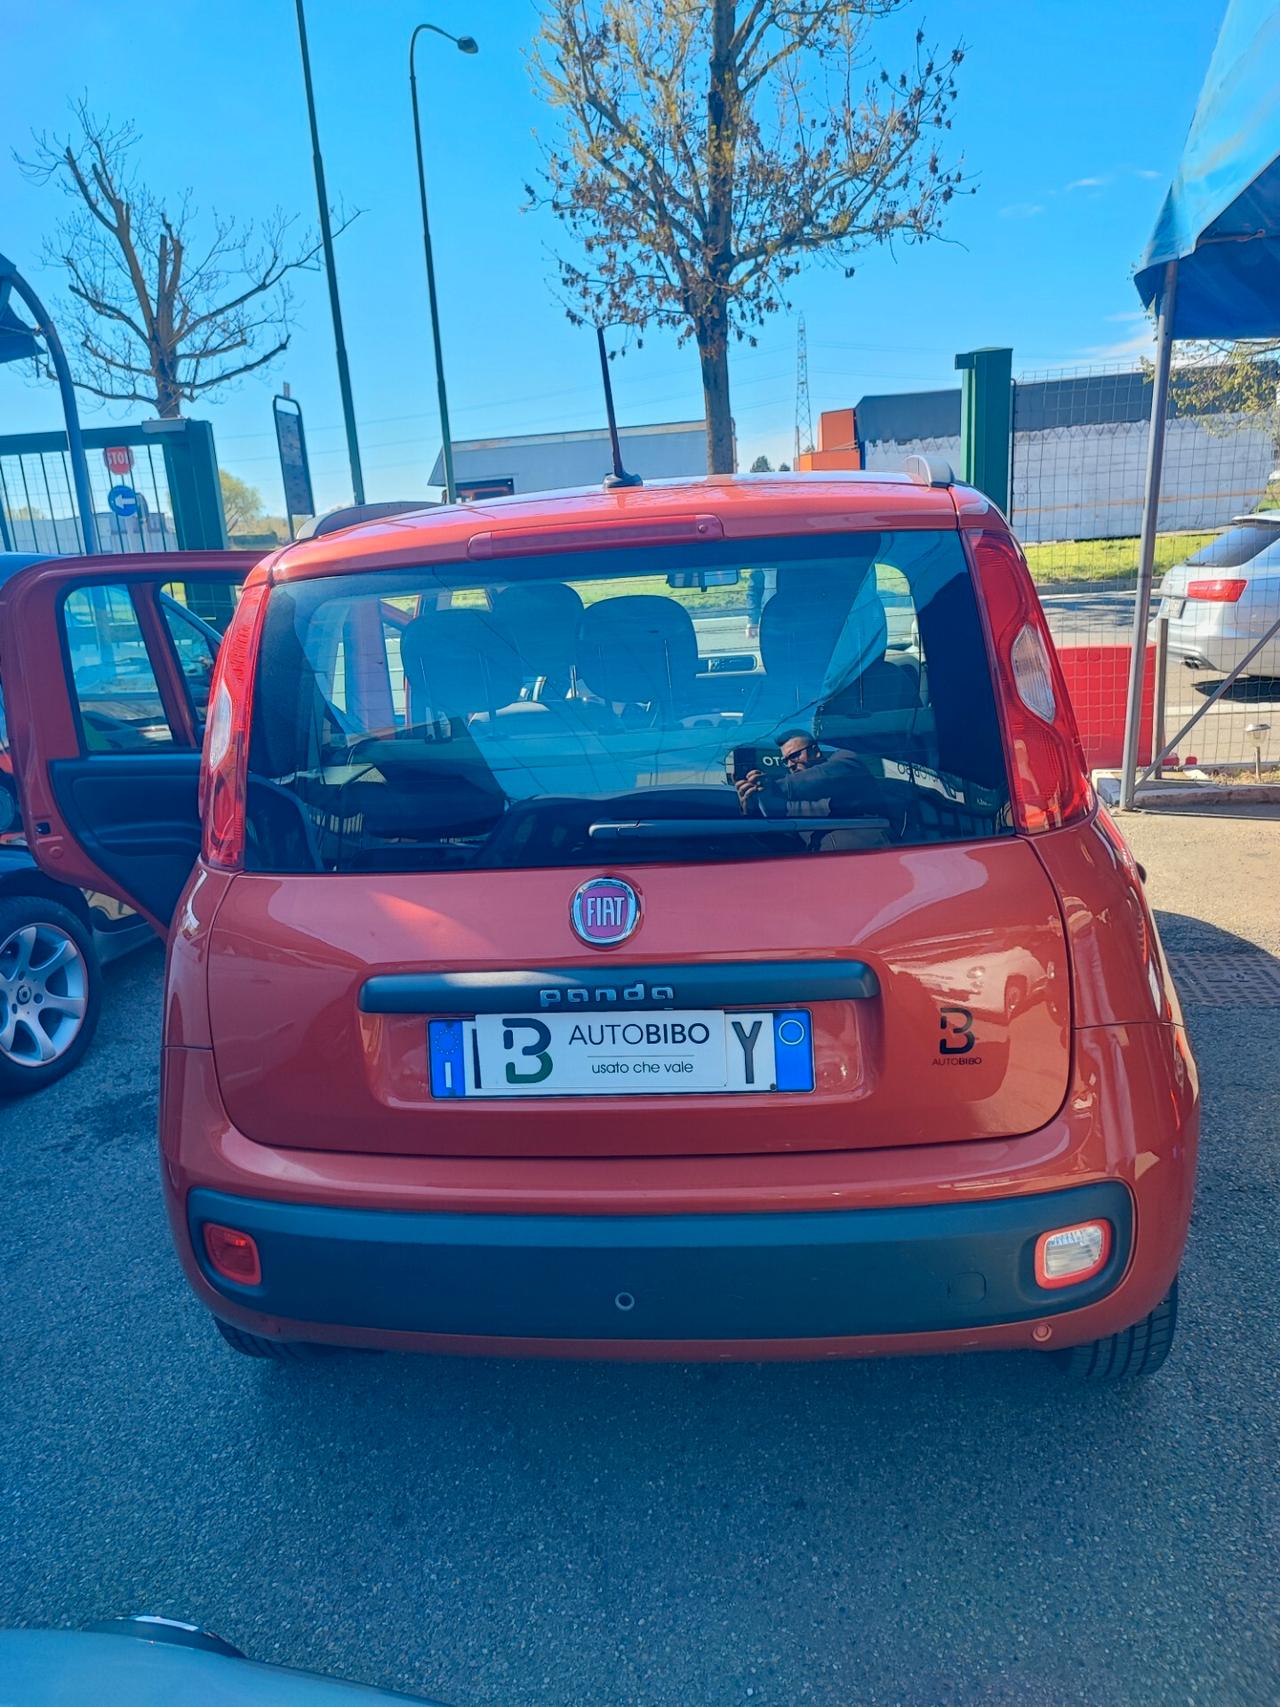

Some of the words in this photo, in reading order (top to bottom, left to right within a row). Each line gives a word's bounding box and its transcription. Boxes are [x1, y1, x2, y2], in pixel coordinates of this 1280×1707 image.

[587, 896, 625, 927] FIAT
[539, 983, 674, 1007] panda
[568, 1022, 710, 1046] AUTOBIBO
[731, 1020, 763, 1085] Y
[932, 1056, 982, 1067] AUTOBIBO
[591, 1061, 630, 1074] usato
[633, 1060, 660, 1073] che
[663, 1060, 694, 1073] vale
